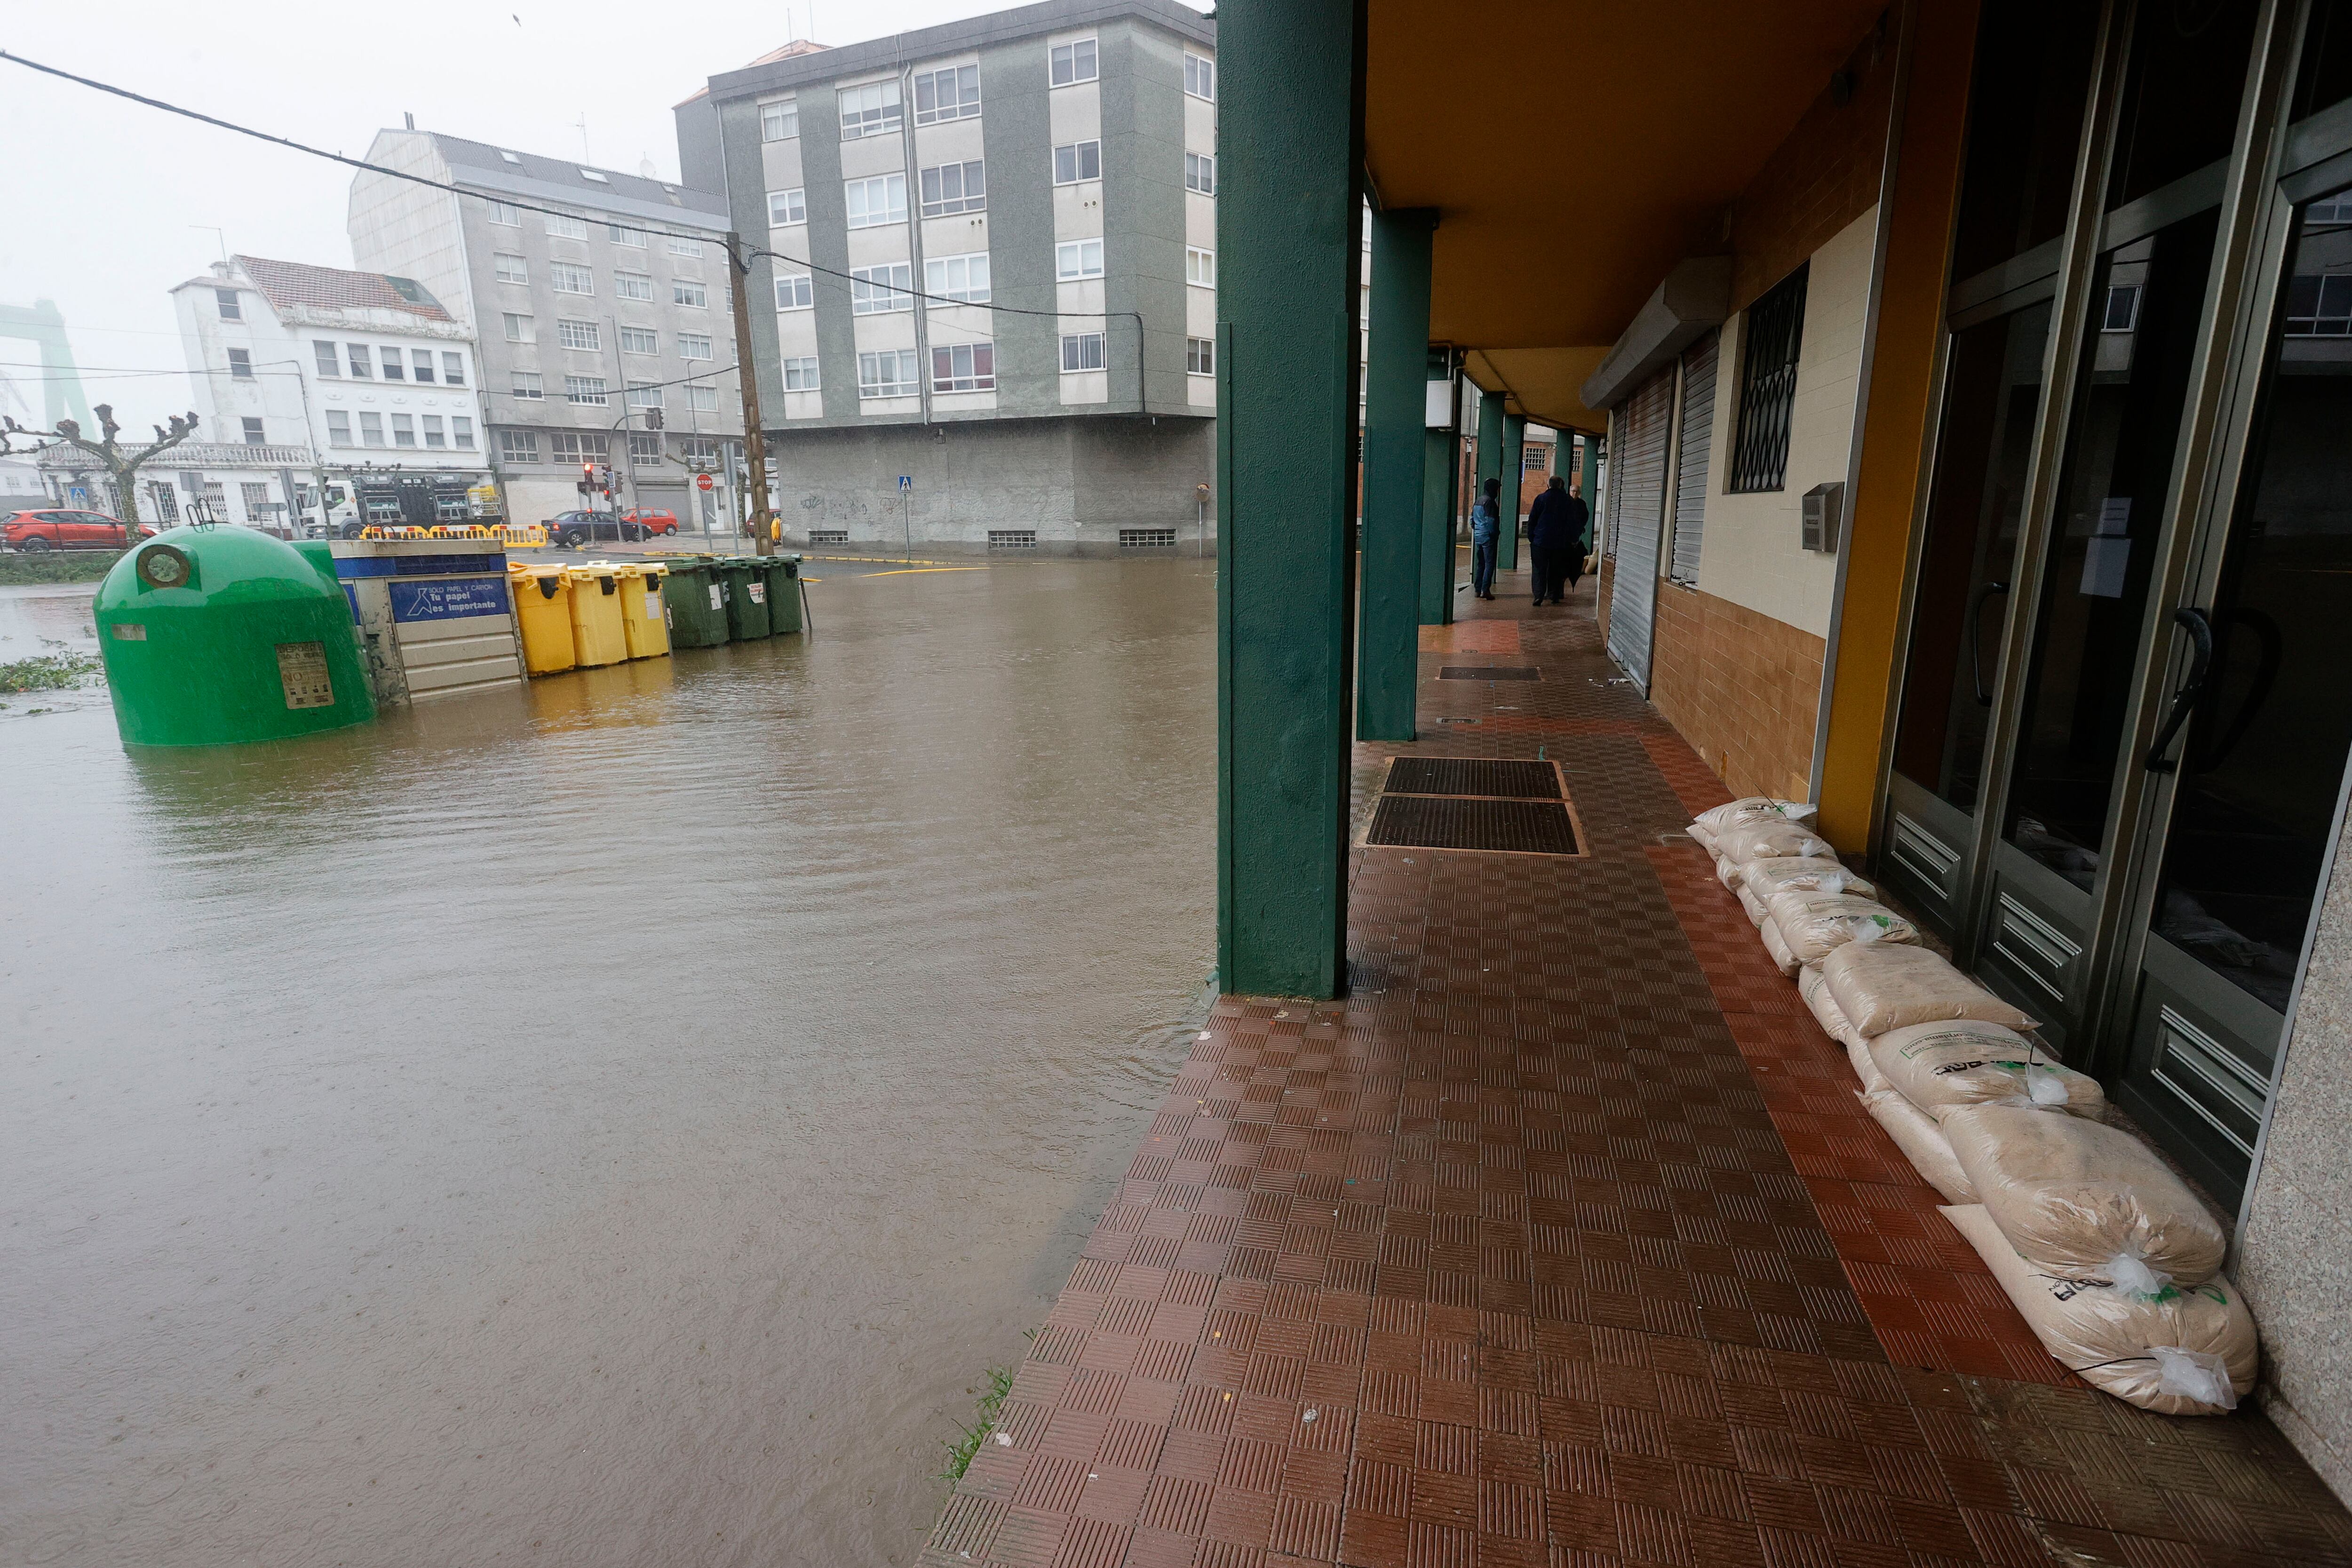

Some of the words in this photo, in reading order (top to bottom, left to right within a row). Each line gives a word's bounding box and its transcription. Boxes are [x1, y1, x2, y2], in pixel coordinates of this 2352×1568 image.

[446, 592, 470, 602] papel
[448, 601, 496, 612] importante
[283, 672, 302, 682] NO
